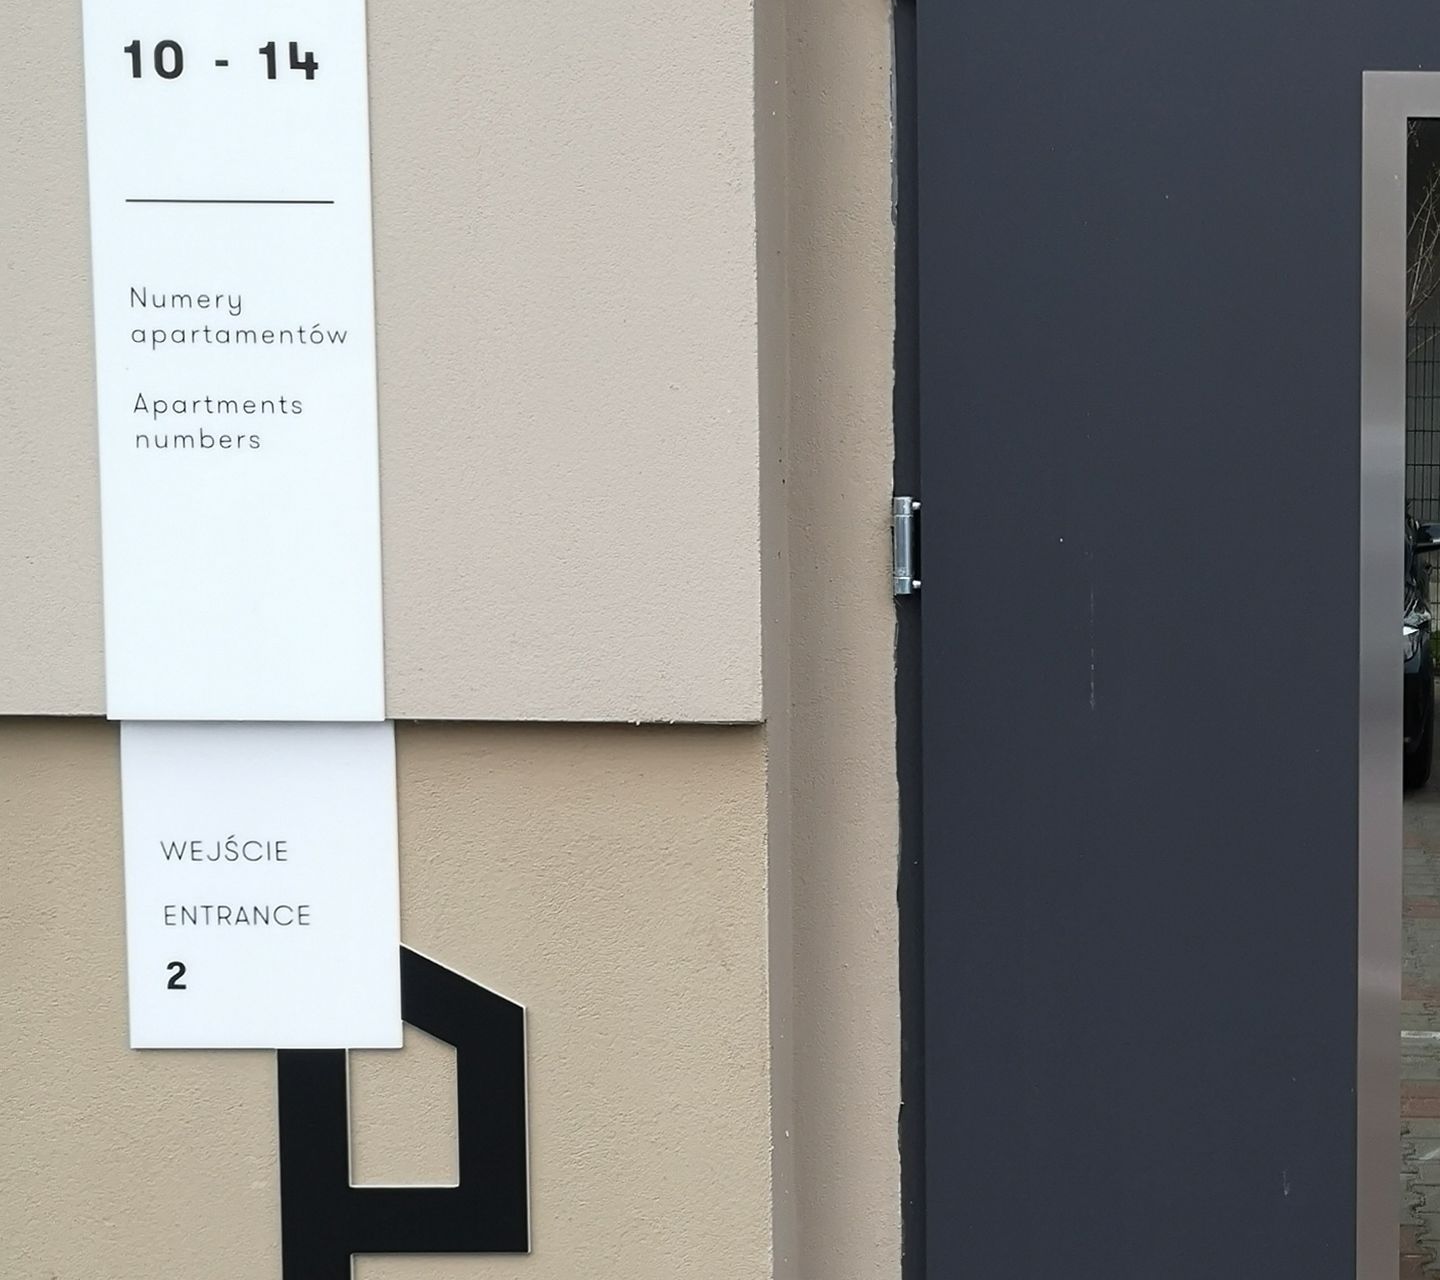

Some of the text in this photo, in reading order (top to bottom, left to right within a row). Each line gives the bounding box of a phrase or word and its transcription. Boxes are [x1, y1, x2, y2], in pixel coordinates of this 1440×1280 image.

[123, 39, 184, 80] 10
[258, 40, 319, 81] 14
[130, 286, 242, 317] Numery
[131, 322, 348, 351] apartamentów
[133, 392, 303, 421] Apartments
[136, 427, 261, 450] numbers
[160, 834, 288, 862] WEJŚCIE
[164, 904, 310, 926] ENTRANCE
[166, 960, 188, 991] 2
